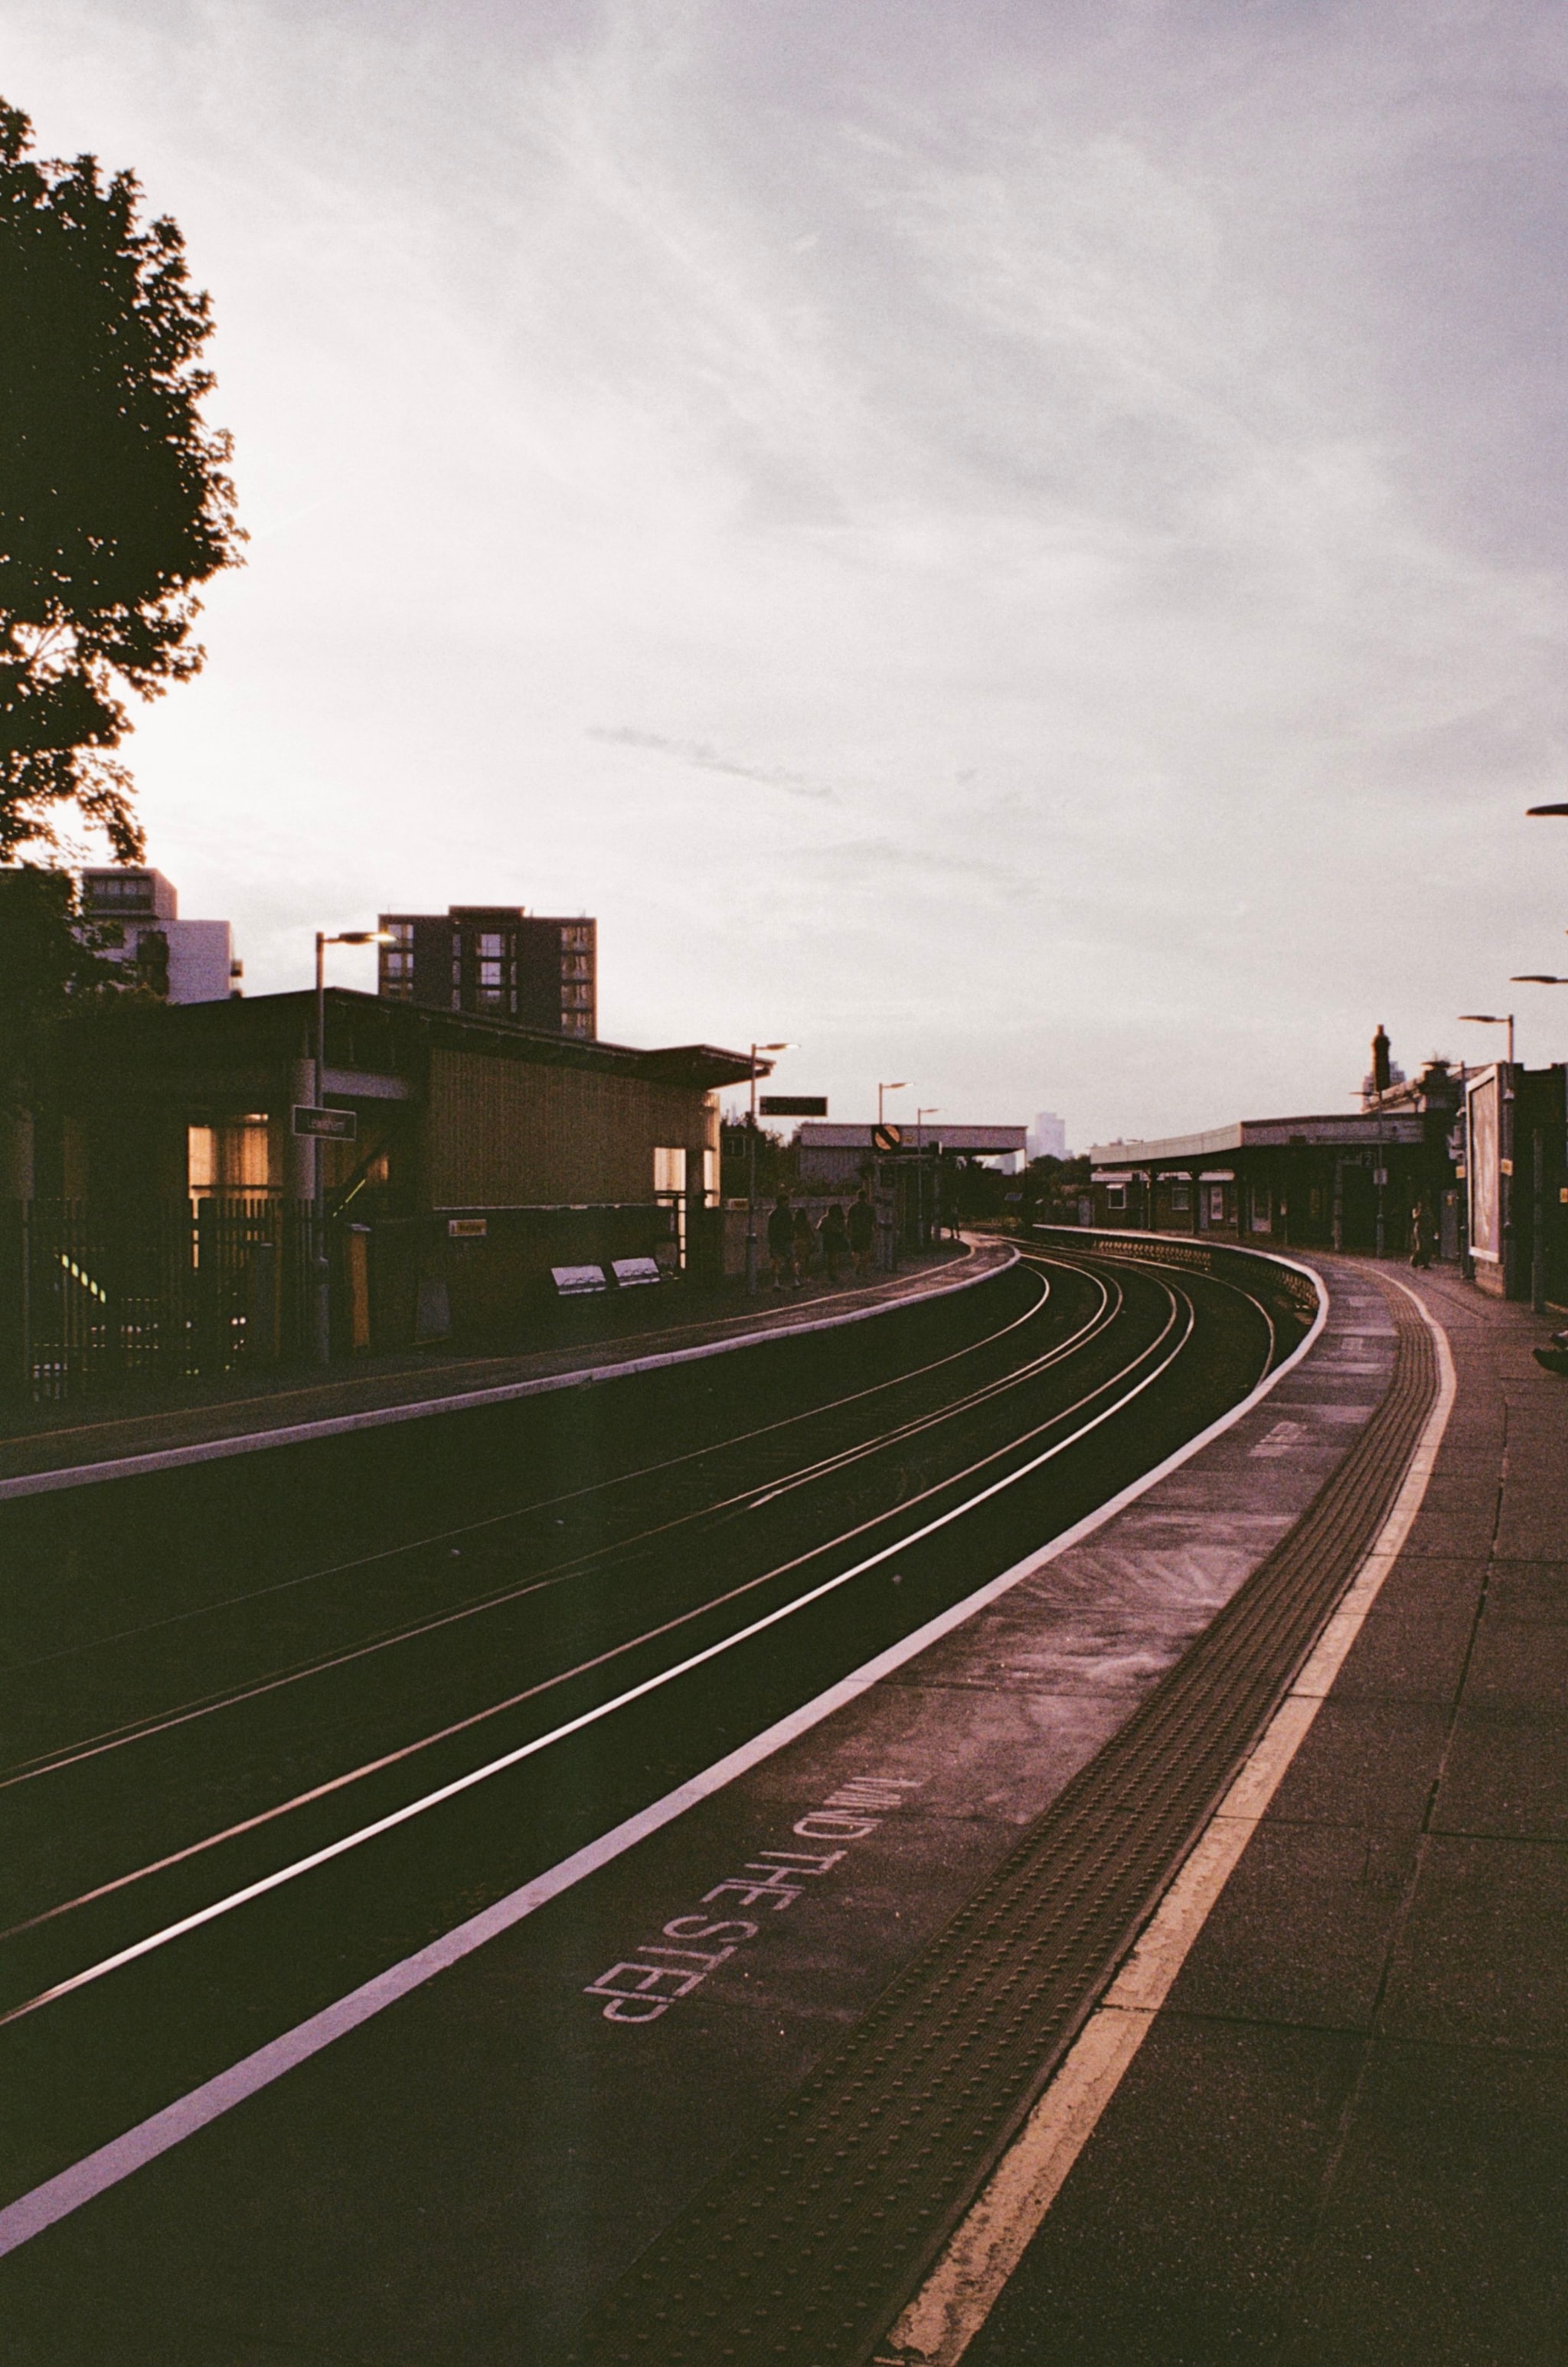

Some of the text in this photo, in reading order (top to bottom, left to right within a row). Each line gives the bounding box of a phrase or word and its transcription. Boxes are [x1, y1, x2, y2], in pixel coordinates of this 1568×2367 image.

[1364, 1154, 1373, 1166] 2
[583, 1776, 926, 2022] MIND THE STEP
